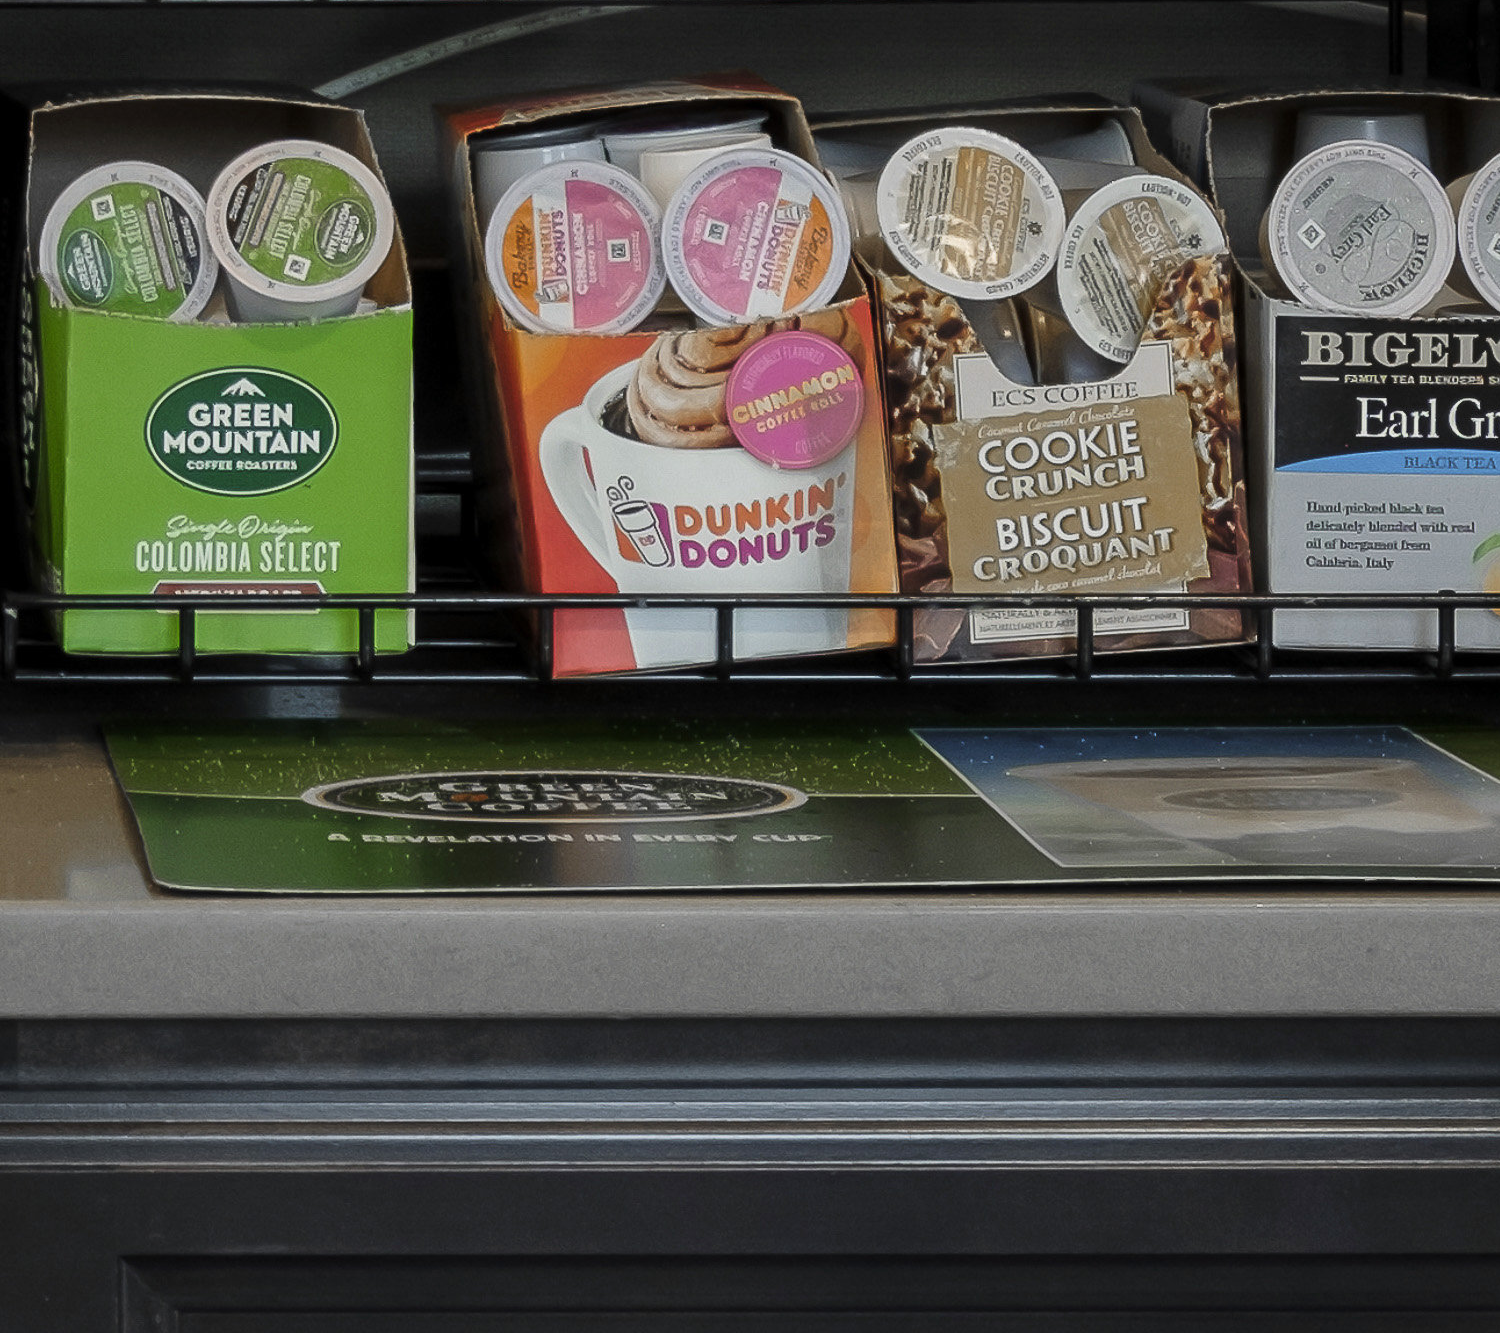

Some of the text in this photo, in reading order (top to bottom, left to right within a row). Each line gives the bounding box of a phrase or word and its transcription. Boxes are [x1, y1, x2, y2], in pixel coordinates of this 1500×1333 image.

[1344, 374, 1388, 385] FAMILY
[1391, 374, 1416, 385] TEA
[1419, 375, 1484, 385] BLENDERS
[732, 363, 856, 425] CINNAMON
[991, 380, 1139, 408] ECS COFFEE
[187, 402, 294, 429] GREEN
[755, 404, 807, 434] COFFEE
[1355, 396, 1440, 440] Earl
[162, 430, 322, 456] MOUNTAIN
[977, 419, 1142, 475] COOKIE
[186, 458, 299, 471] COFFEE ROASTERS
[1403, 456, 1497, 470] BLACK TEA
[985, 455, 1147, 502] CRUNCH
[1389, 502, 1424, 515] black
[1426, 504, 1445, 515] tea
[166, 514, 237, 539] Single
[995, 496, 1149, 553] BISCUIT
[1306, 521, 1476, 535] delicately blended with real
[679, 513, 837, 569] DONUTS
[972, 527, 1175, 582] CROQUANT
[1305, 537, 1431, 553] oil of bergamot from
[135, 540, 342, 574] COLOMBIA SELECT
[1365, 556, 1395, 571] Italy
[326, 833, 352, 843] A
[361, 832, 575, 844] REVELATION
[584, 832, 623, 843] IN
[632, 832, 740, 844] EVERY
